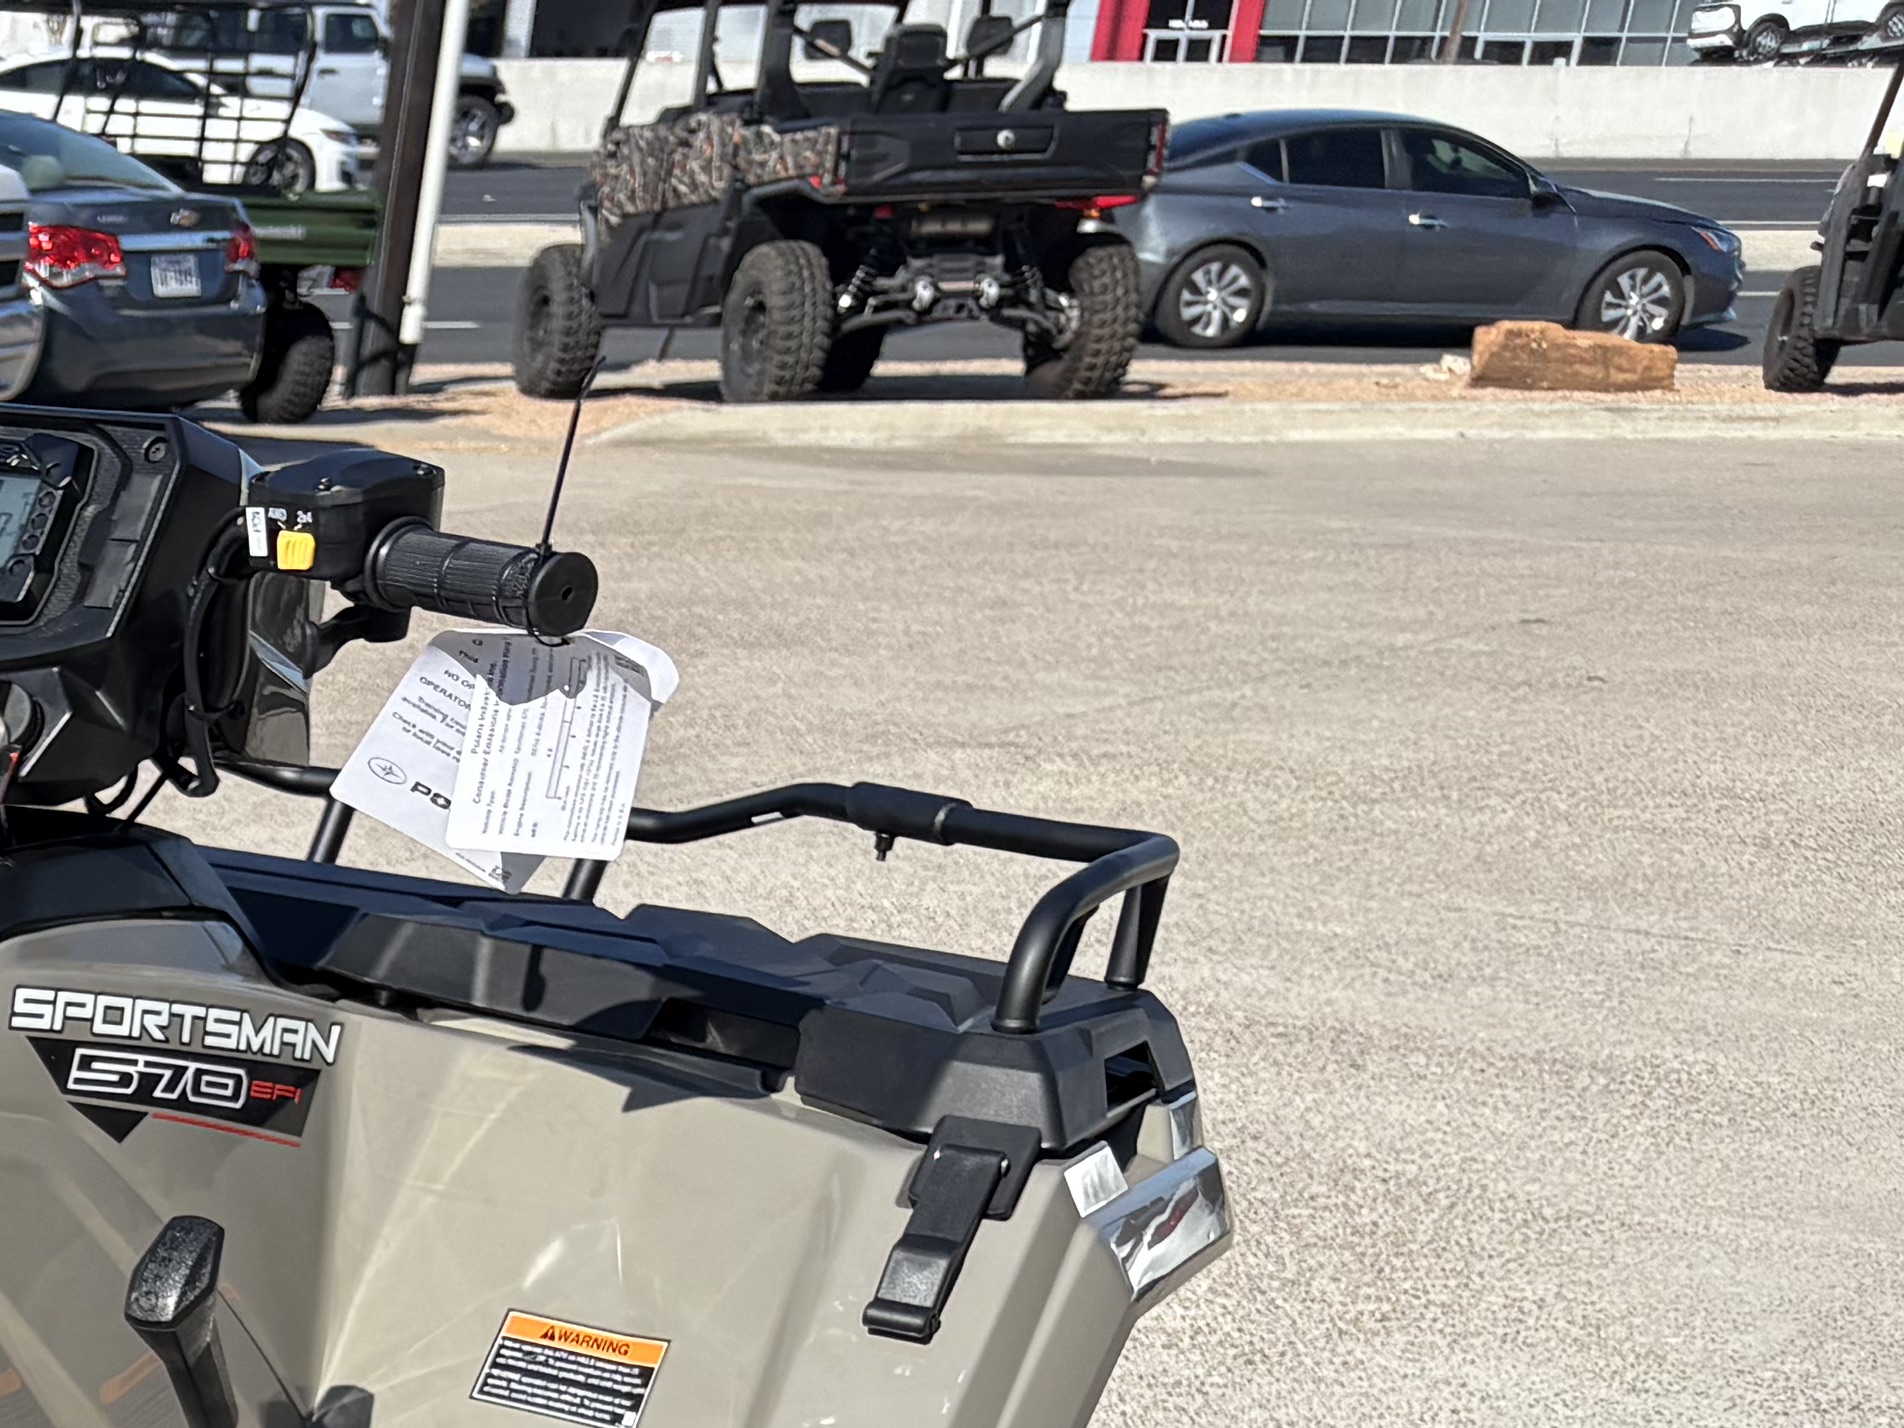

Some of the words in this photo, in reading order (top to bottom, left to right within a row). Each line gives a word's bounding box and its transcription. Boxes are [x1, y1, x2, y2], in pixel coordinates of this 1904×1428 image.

[9, 986, 341, 1065] SPORTSMAN
[66, 1047, 251, 1110] 570
[249, 1079, 303, 1106] EFI
[557, 1326, 630, 1359] WARNING
